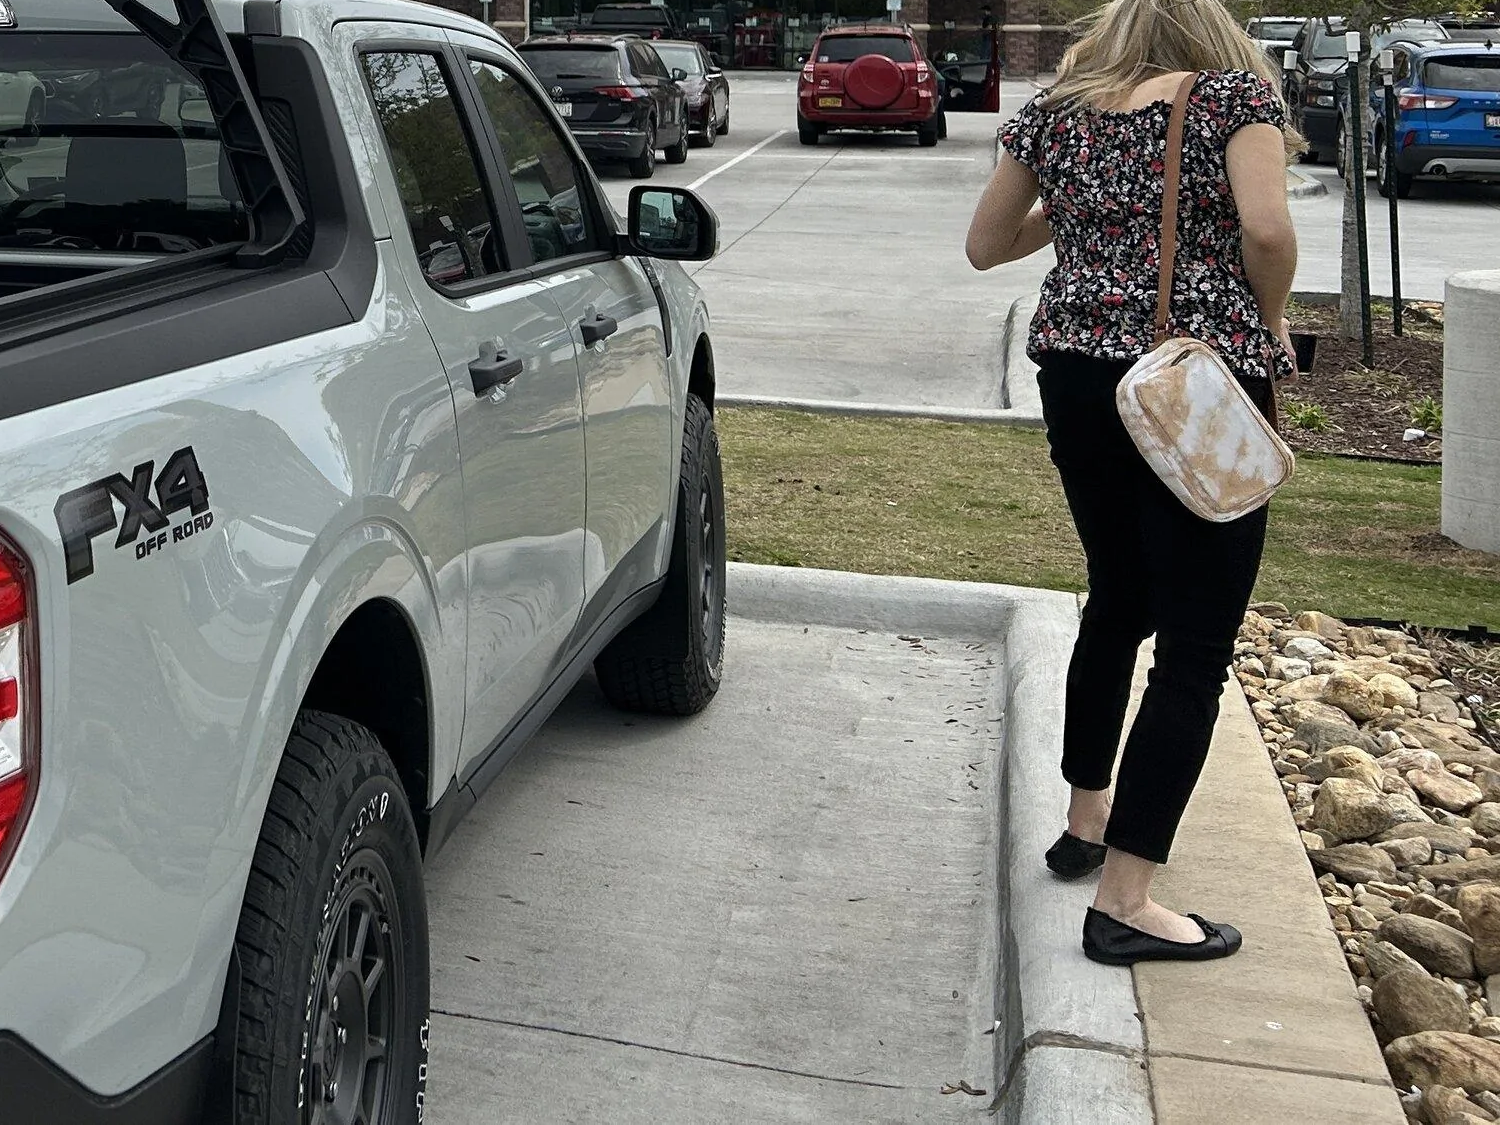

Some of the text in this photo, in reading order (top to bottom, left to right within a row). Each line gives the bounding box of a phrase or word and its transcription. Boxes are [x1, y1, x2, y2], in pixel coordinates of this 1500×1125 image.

[53, 445, 210, 586] FX4
[135, 511, 214, 560] OFF ROAD
